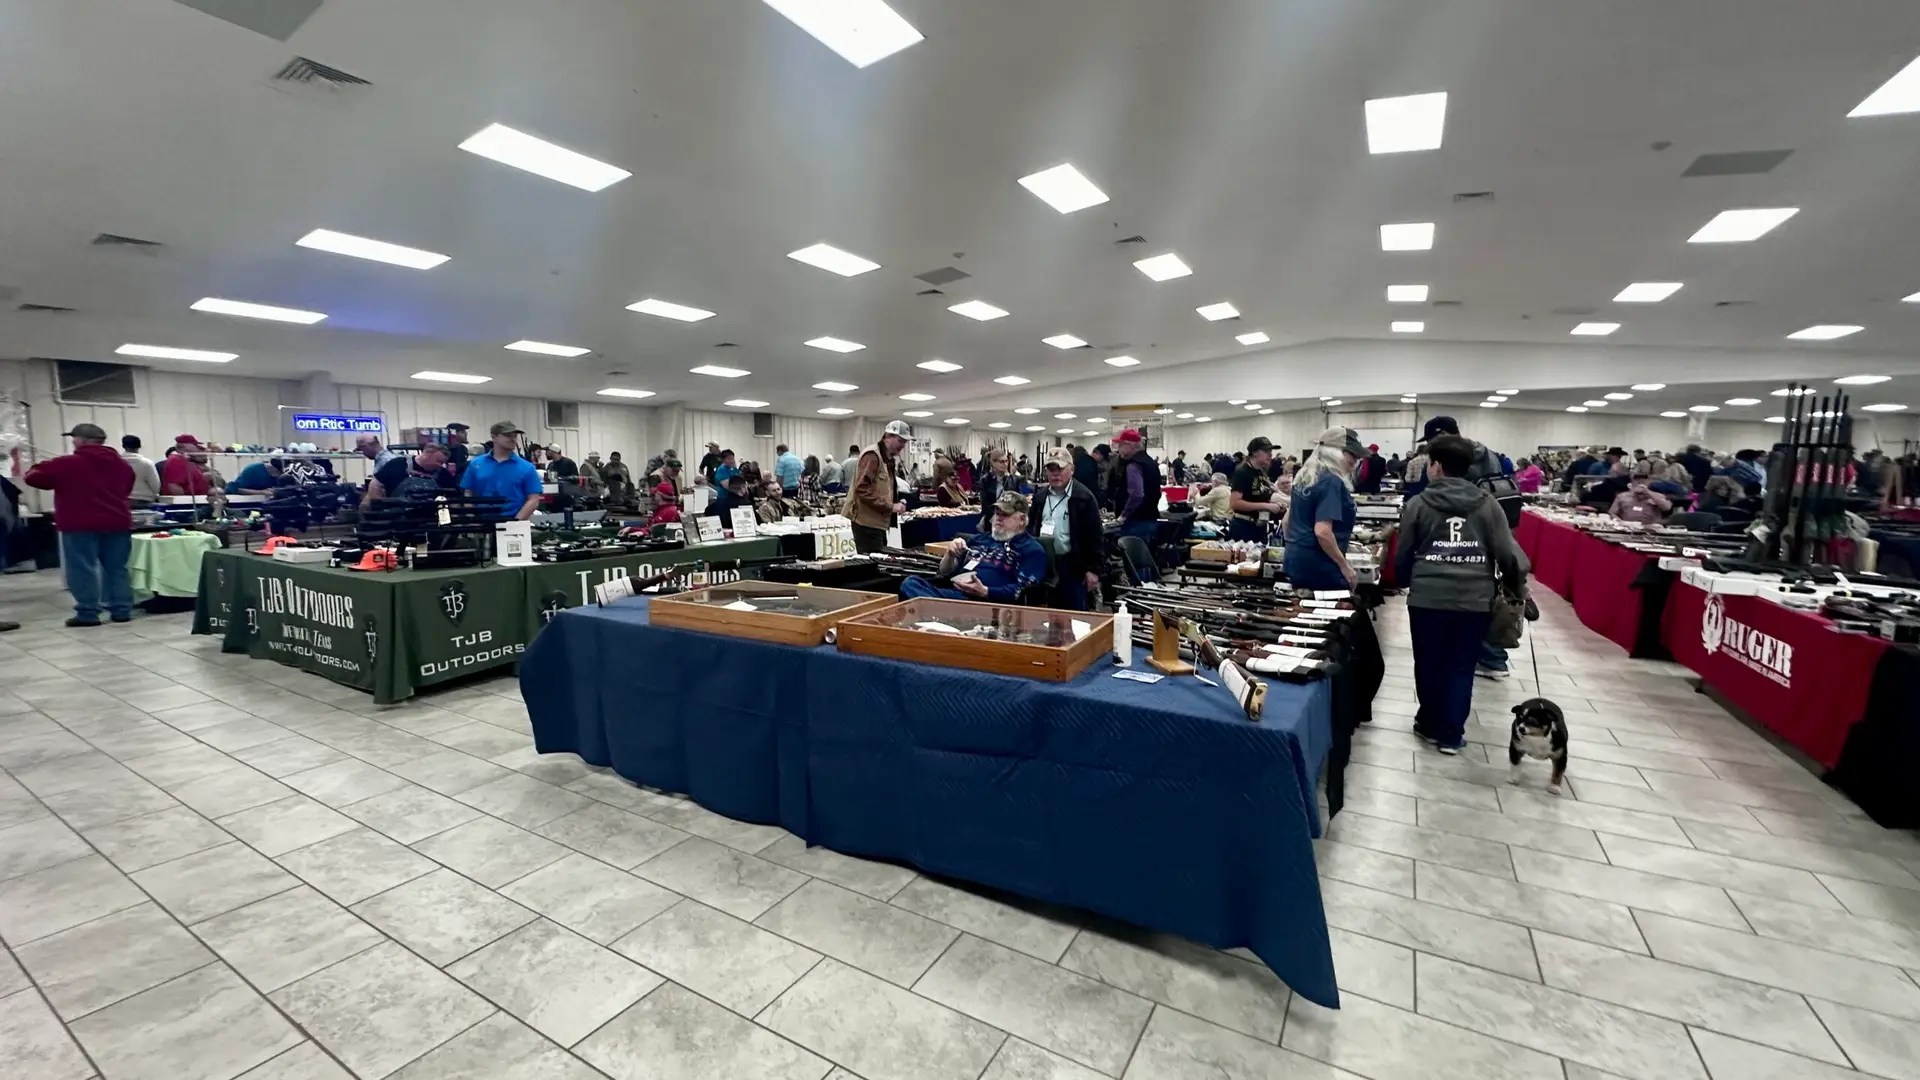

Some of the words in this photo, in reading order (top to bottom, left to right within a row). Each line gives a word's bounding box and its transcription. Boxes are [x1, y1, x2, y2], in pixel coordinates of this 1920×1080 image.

[347, 419, 381, 431] Tumb
[257, 576, 285, 614] TJB
[451, 630, 493, 648] TJB
[1723, 616, 1793, 678] RUGER
[420, 643, 526, 676] OUTDOORS
